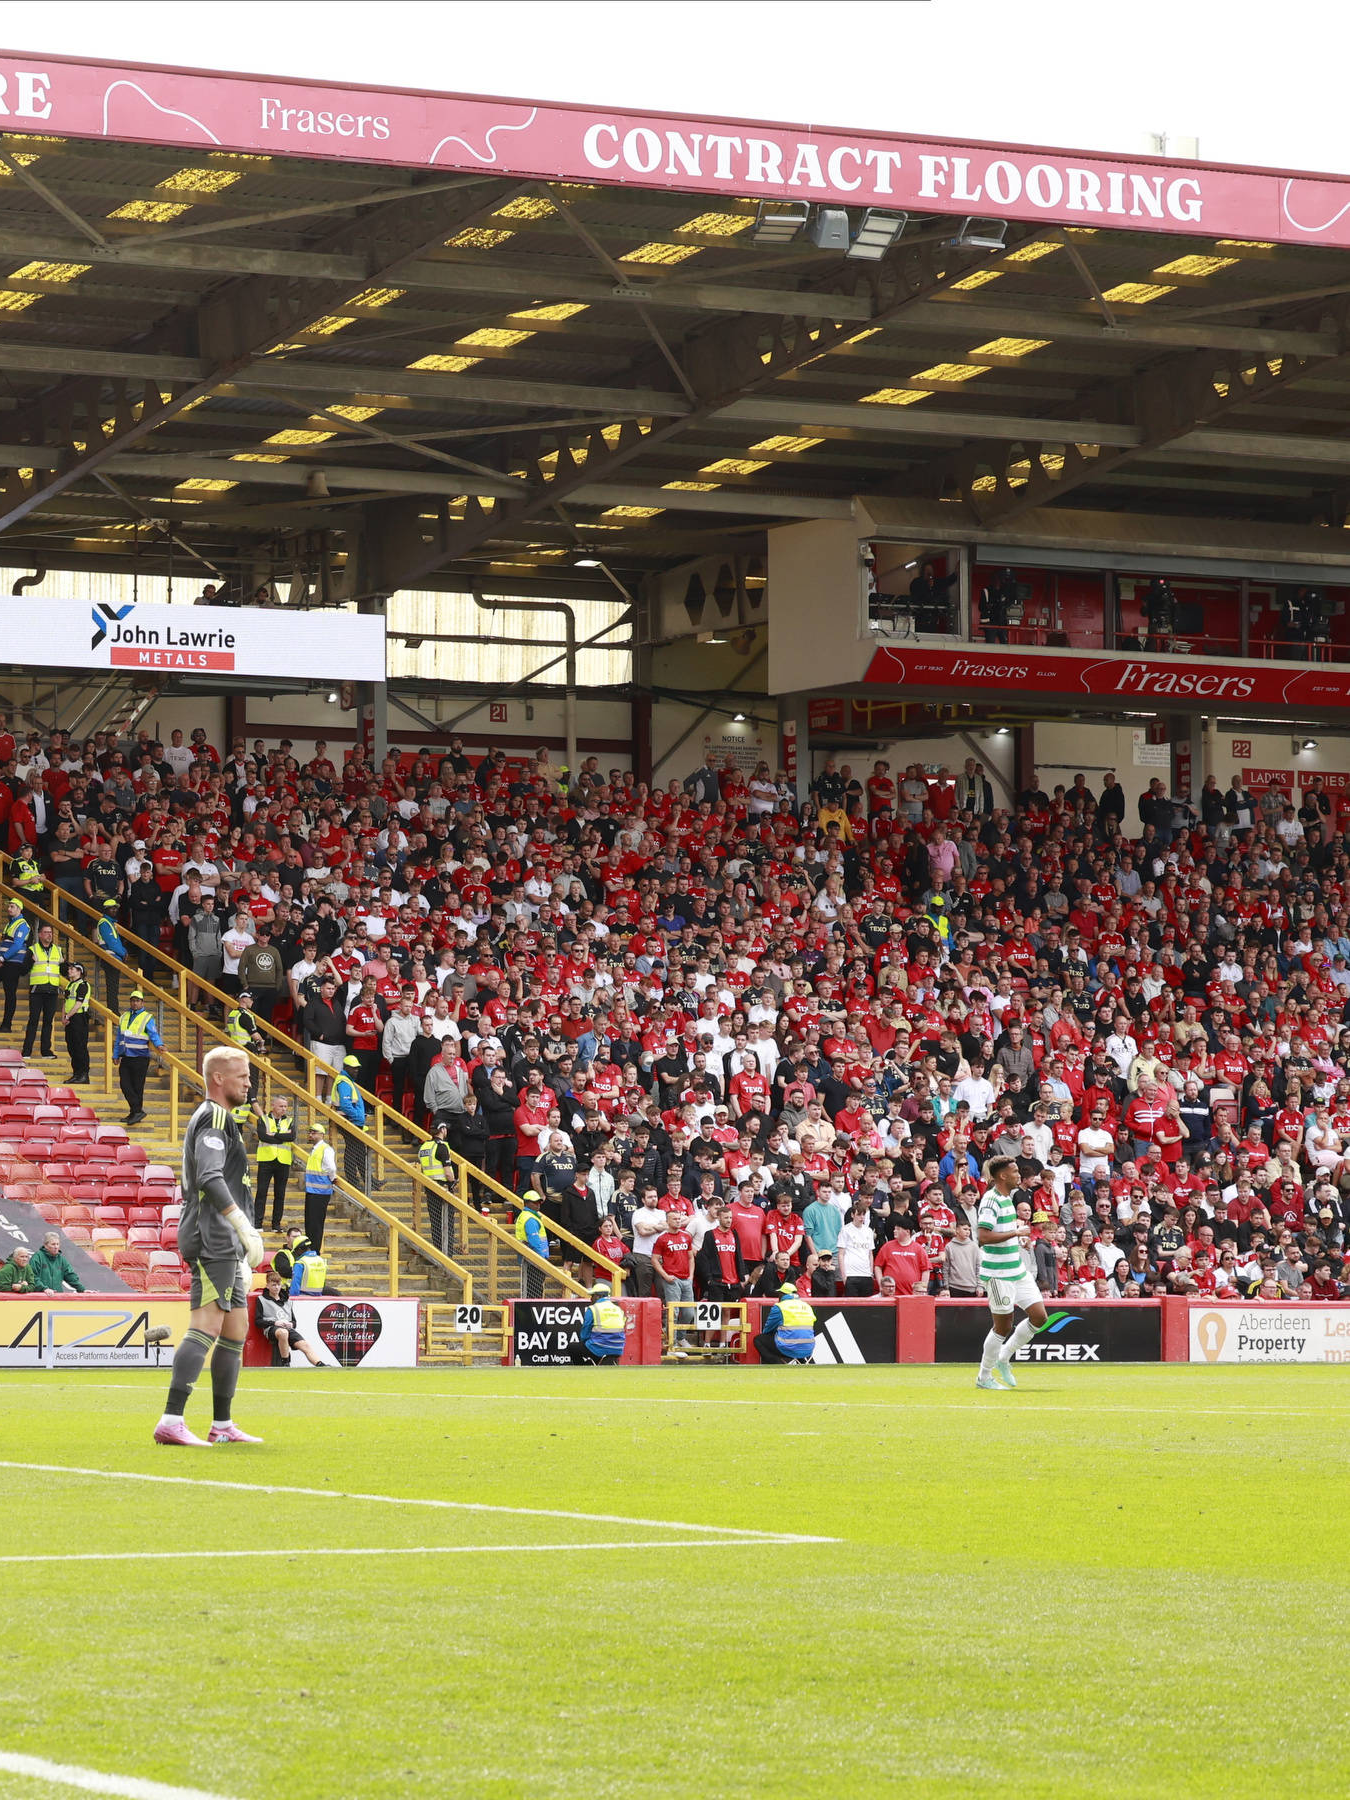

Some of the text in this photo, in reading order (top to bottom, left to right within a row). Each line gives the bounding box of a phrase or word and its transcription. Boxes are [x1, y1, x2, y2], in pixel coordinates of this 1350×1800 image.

[260, 98, 391, 142] Frasers
[583, 124, 1203, 222] CONTRACT FLOORING
[111, 622, 235, 649] John Lawrie
[139, 651, 208, 667] METALS
[950, 659, 1029, 679] Frasers
[1114, 663, 1257, 697] Frasers
[491, 706, 507, 721] 21
[1153, 723, 1165, 742] T
[1234, 742, 1250, 757] 22
[1301, 775, 1346, 787] LAIES
[592, 1083, 610, 1091] TEXO
[669, 1243, 688, 1251] TEXO
[717, 1244, 736, 1252] TEXO
[330, 1310, 346, 1318] Miss
[351, 1310, 371, 1318] Cook's
[458, 1307, 480, 1325] 20
[532, 1307, 585, 1325] VEGA
[698, 1303, 719, 1322] 20
[330, 1322, 368, 1330] Traditional
[1238, 1314, 1311, 1330] Aberdeen
[326, 1332, 375, 1341] Scottish Tablet
[518, 1332, 552, 1350] BAY
[1238, 1335, 1306, 1354] Property
[56, 1352, 139, 1360] Access Platforms Aberdeen
[532, 1354, 549, 1362] Craft
